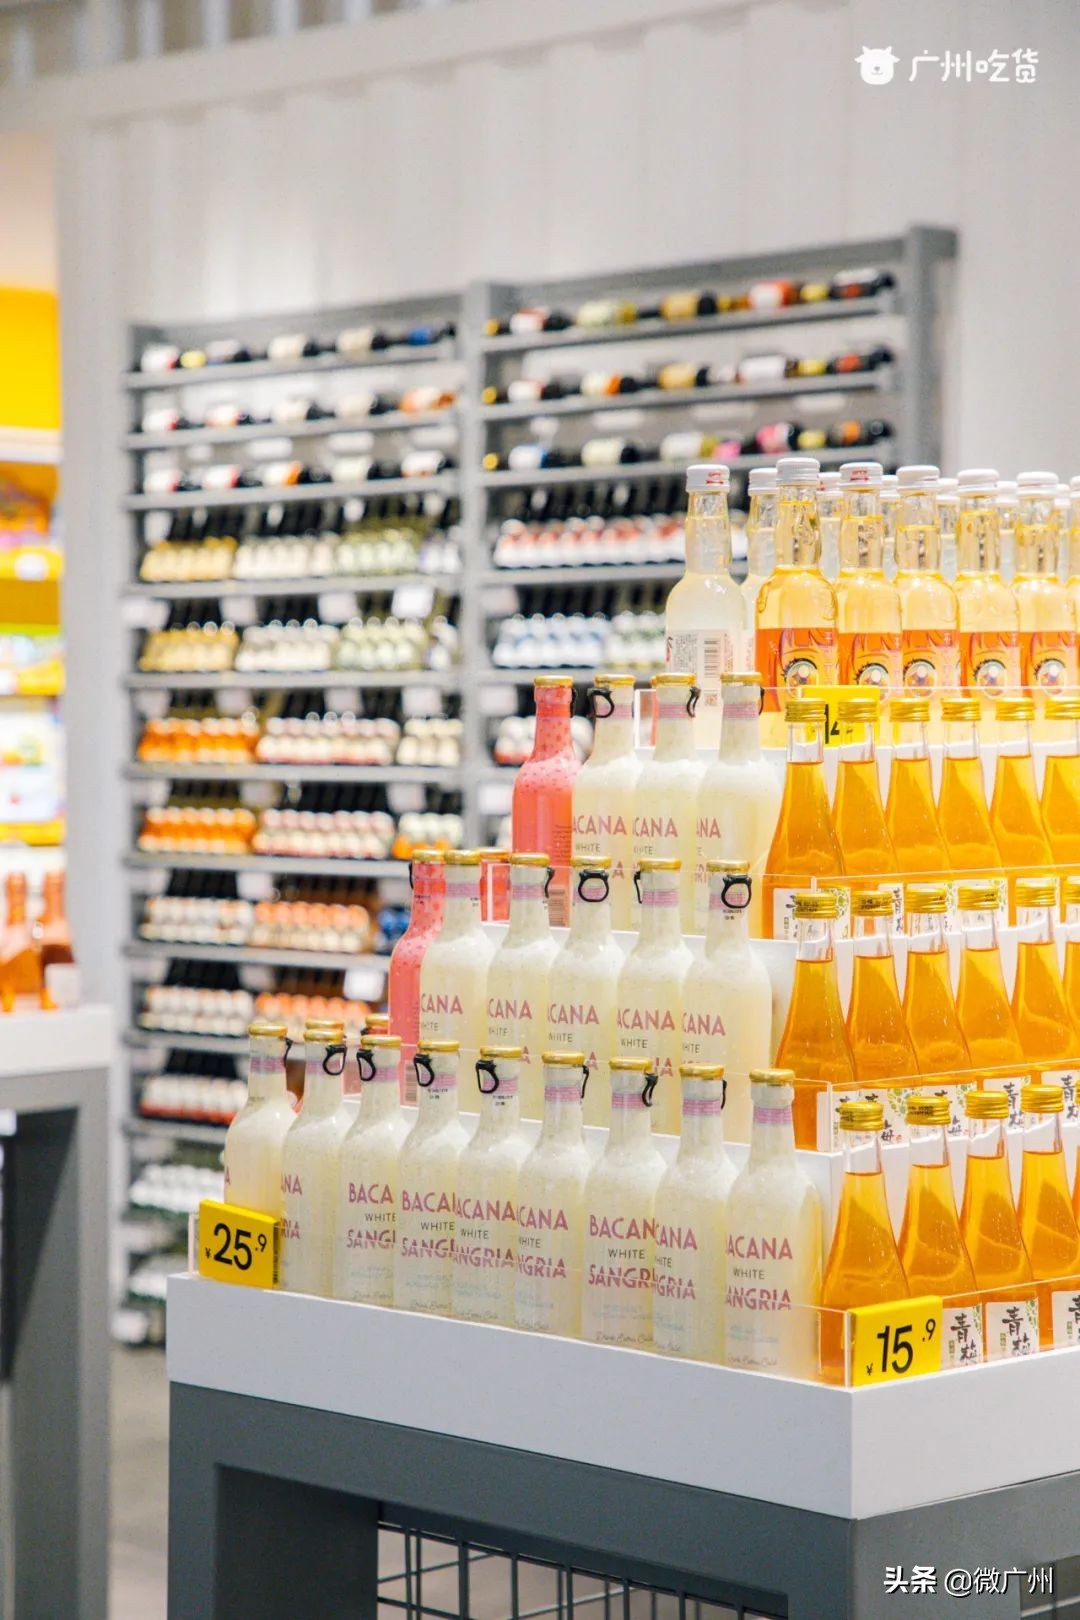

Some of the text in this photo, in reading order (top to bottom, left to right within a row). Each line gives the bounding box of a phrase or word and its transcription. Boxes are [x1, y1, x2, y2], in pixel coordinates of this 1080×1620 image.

[364, 1212, 396, 1223] WHITE
[420, 1221, 455, 1232] WHITE
[608, 1247, 646, 1260] WHITE
[733, 1267, 766, 1280] WHITE
